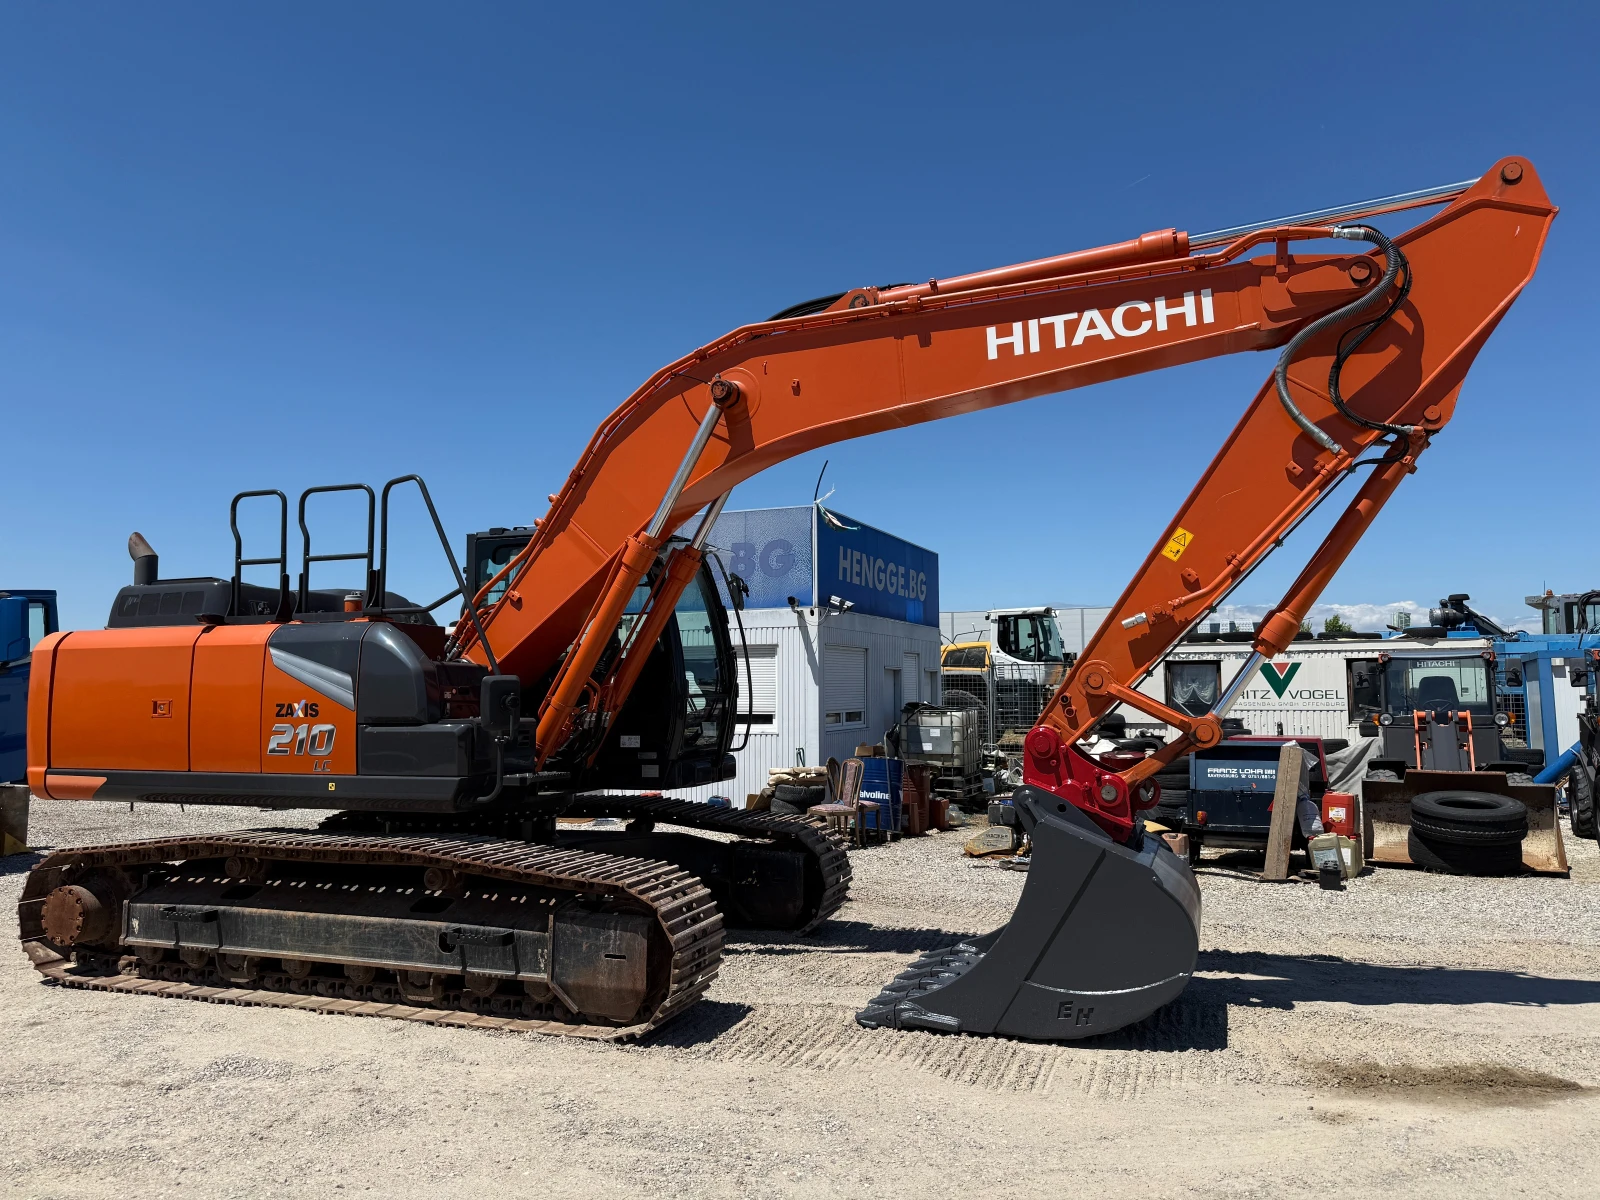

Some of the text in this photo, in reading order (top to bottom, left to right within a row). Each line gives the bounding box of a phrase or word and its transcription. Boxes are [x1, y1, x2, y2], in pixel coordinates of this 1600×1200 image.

[986, 288, 1214, 360] HITACHI
[838, 545, 927, 601] HENGGE.BG
[1288, 690, 1345, 699] VOGEL
[275, 699, 319, 718] ZAXIS
[267, 723, 336, 756] 210
[313, 760, 332, 772] LC
[860, 790, 891, 800] alvoline
